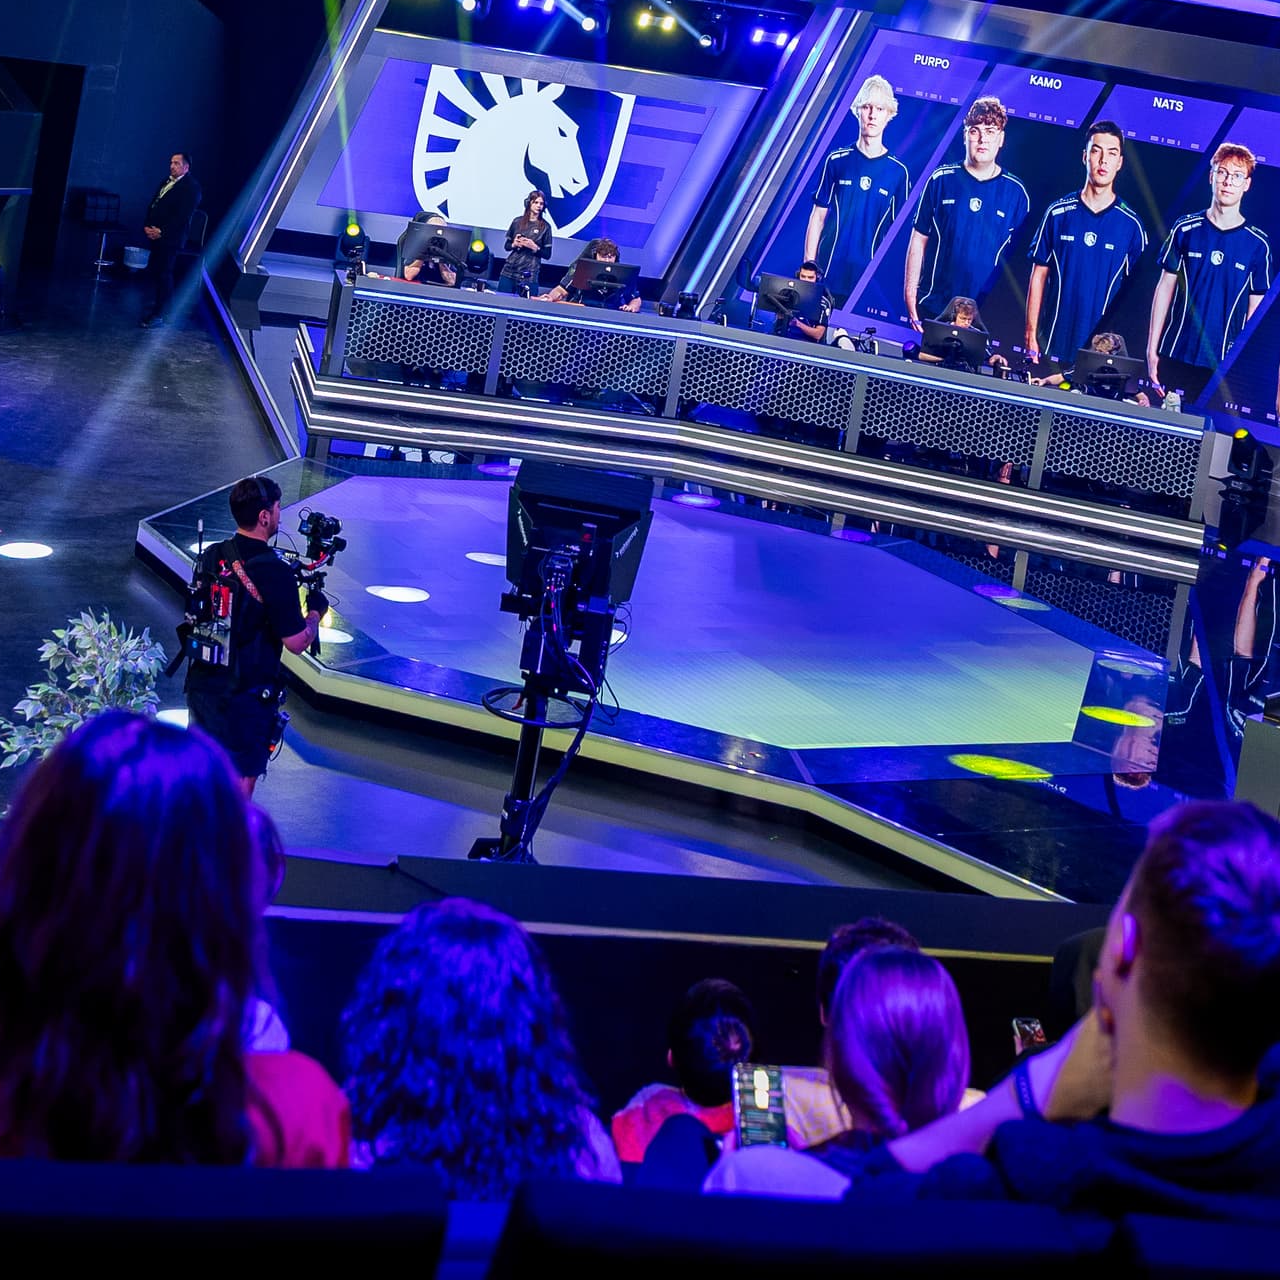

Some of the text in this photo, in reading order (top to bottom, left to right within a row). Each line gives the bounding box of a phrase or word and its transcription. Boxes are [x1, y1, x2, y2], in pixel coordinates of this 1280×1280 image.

[914, 54, 950, 69] PURPO
[1029, 75, 1063, 90] KAMO
[1153, 97, 1184, 113] NATS
